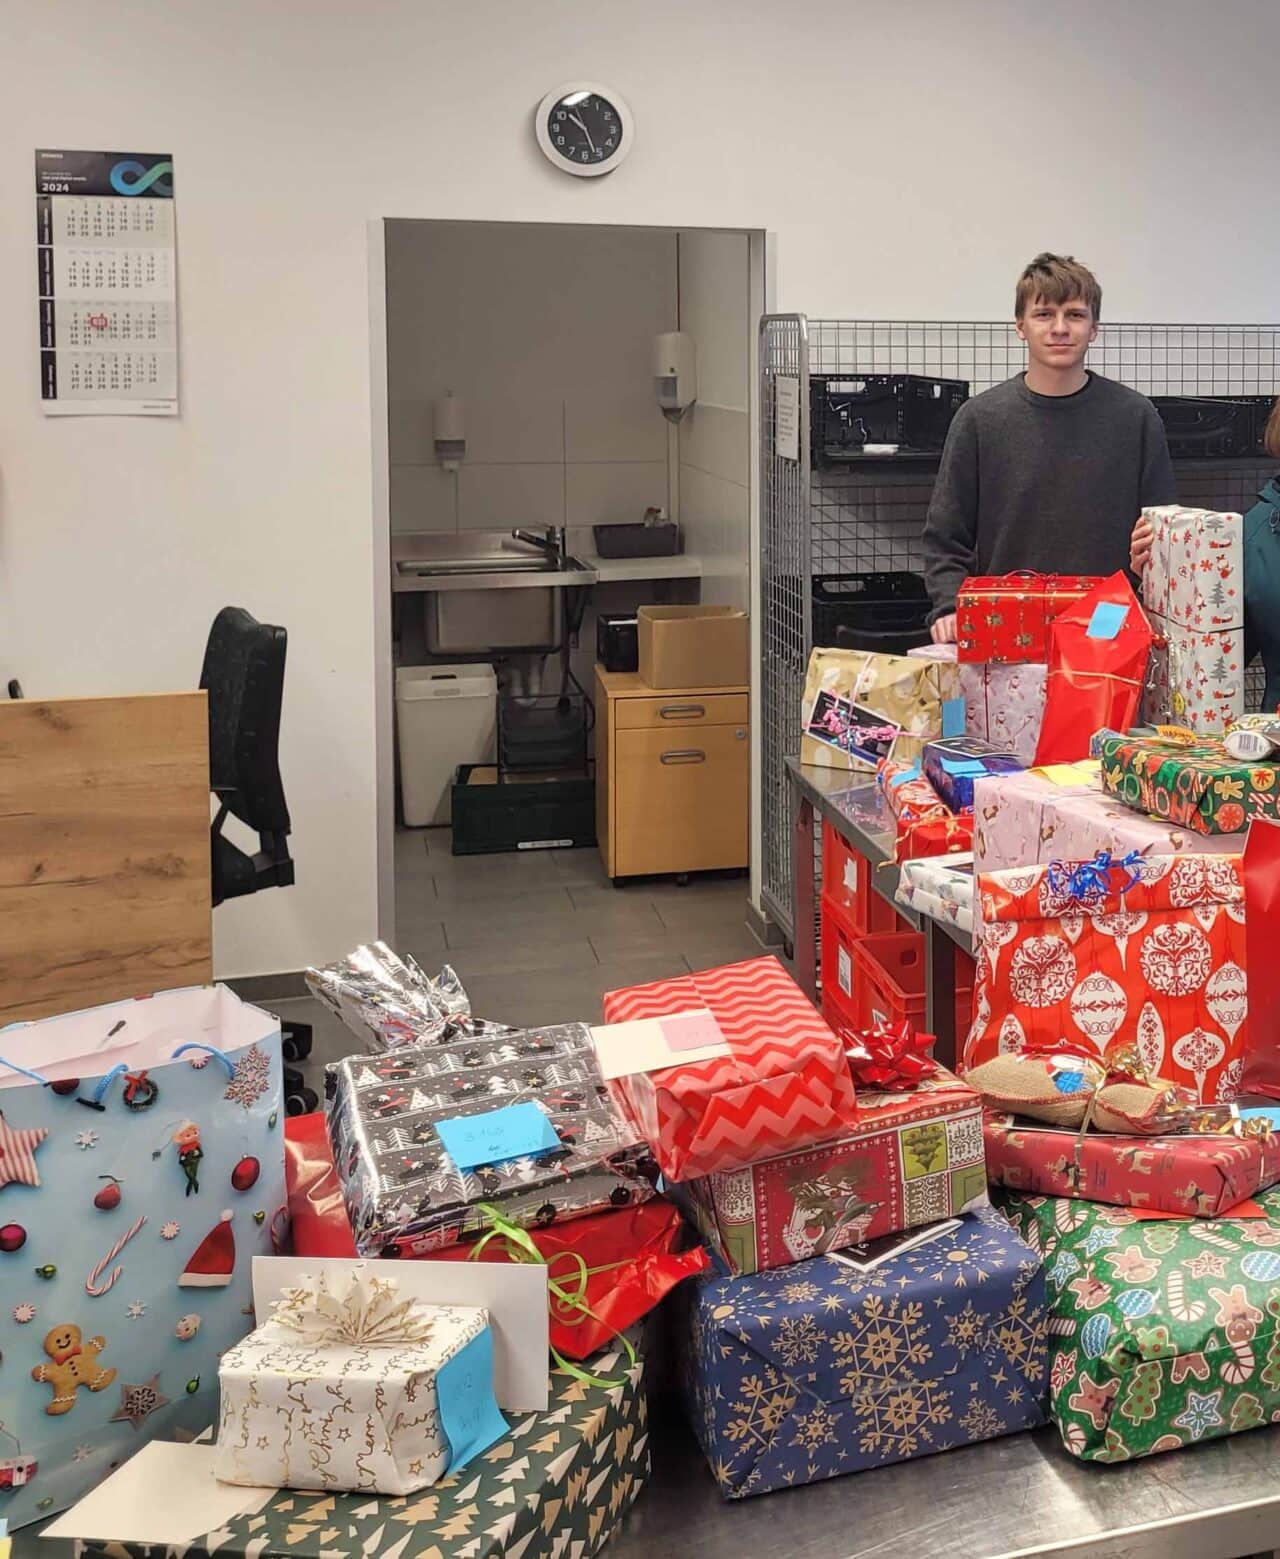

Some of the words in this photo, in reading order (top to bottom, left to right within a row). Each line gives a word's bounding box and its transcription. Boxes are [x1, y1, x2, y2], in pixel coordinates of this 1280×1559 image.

[557, 111, 567, 120] 10
[604, 112, 612, 120] 2
[553, 123, 560, 132] 9
[609, 126, 616, 134] 3
[557, 136, 565, 145] 8
[605, 138, 613, 146] 4
[568, 147, 576, 155] 7
[582, 151, 588, 160] 6
[596, 148, 603, 159] 5
[42, 183, 70, 193] 2024
